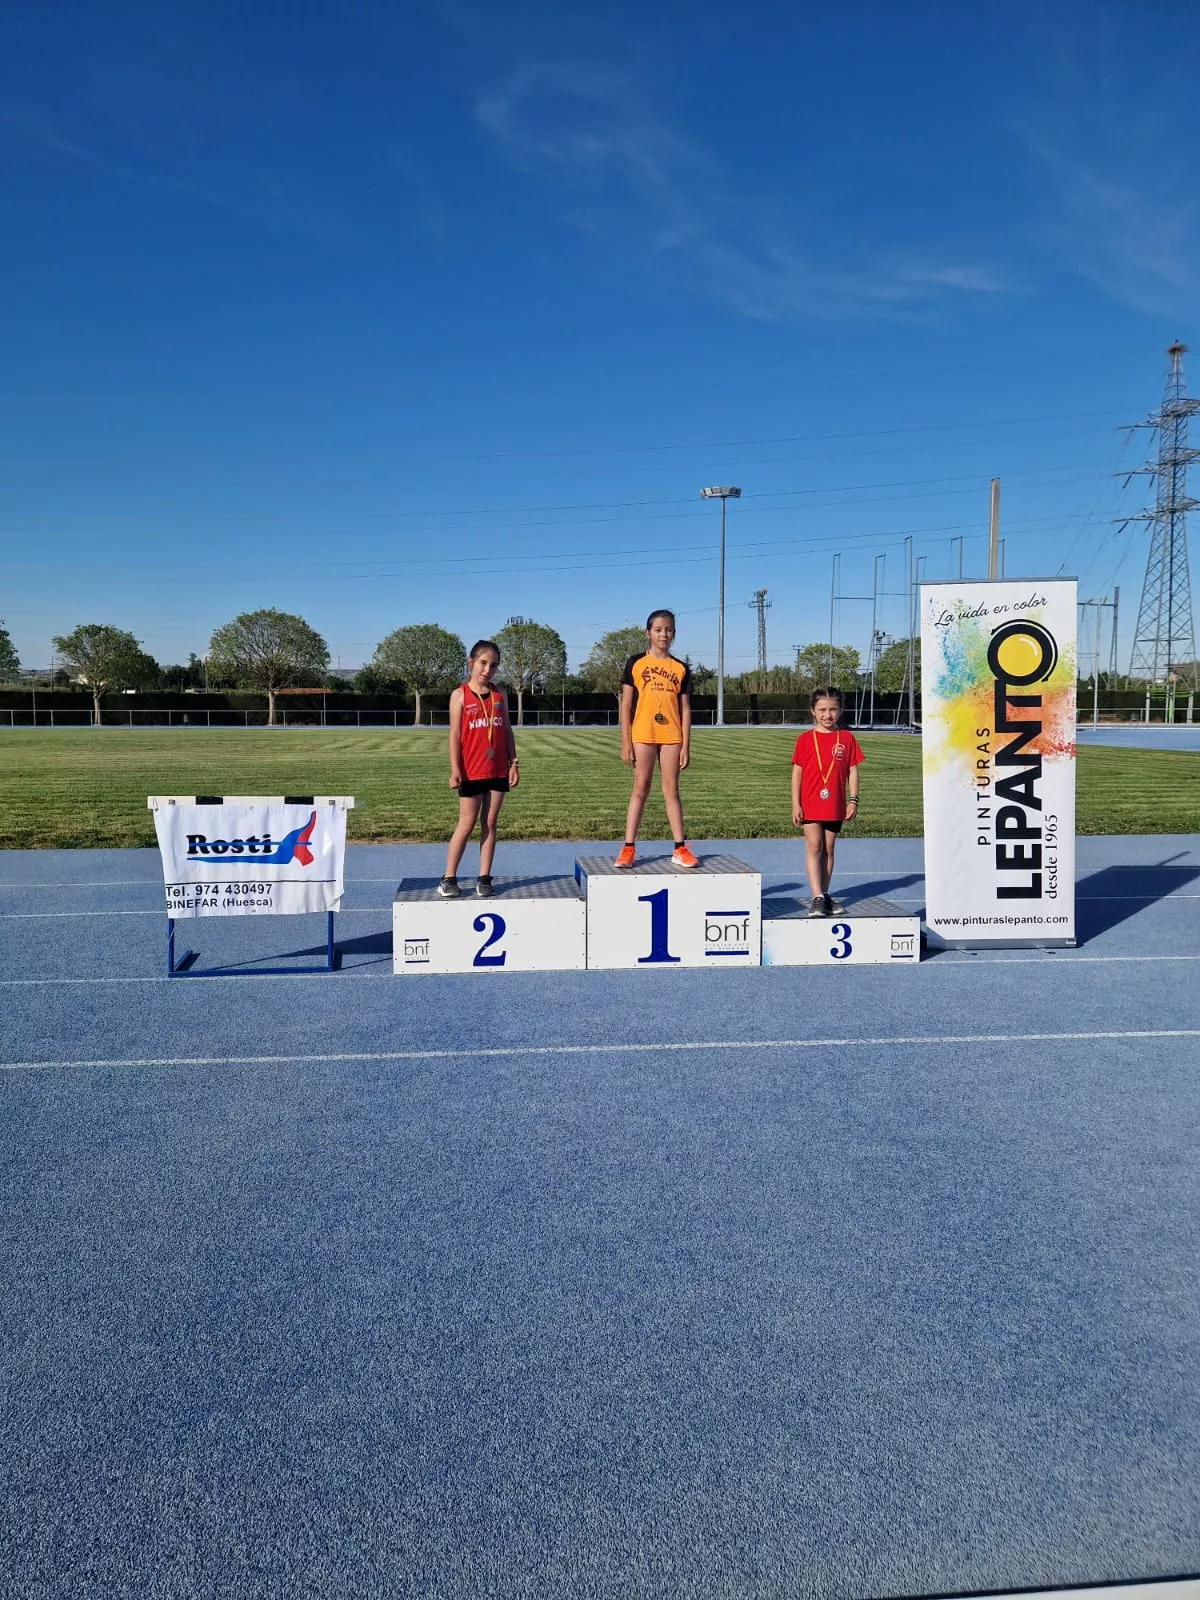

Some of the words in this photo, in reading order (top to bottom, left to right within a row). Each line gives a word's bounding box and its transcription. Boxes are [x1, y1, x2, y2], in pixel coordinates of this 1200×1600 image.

[934, 609, 955, 627] La
[958, 601, 990, 620] vida
[993, 604, 1010, 615] en
[1013, 592, 1048, 611] color
[988, 619, 1058, 899] LEPANTO
[976, 727, 991, 846] PINTURAS
[186, 834, 272, 855] Rosti
[1045, 814, 1058, 850] 1965
[166, 885, 190, 897] Tel.
[195, 884, 219, 895] 974
[225, 883, 272, 895] 430497
[1045, 856, 1058, 899] desde
[166, 898, 218, 909] BINEFAR
[222, 897, 273, 908] (Huesca)
[934, 915, 1069, 926] www.pinturaslepanto.com
[473, 913, 506, 966] 2
[638, 888, 681, 963] 1
[705, 918, 749, 942] bnf
[830, 923, 853, 959] 3
[404, 943, 429, 956] bnf
[890, 938, 914, 951] bnf
